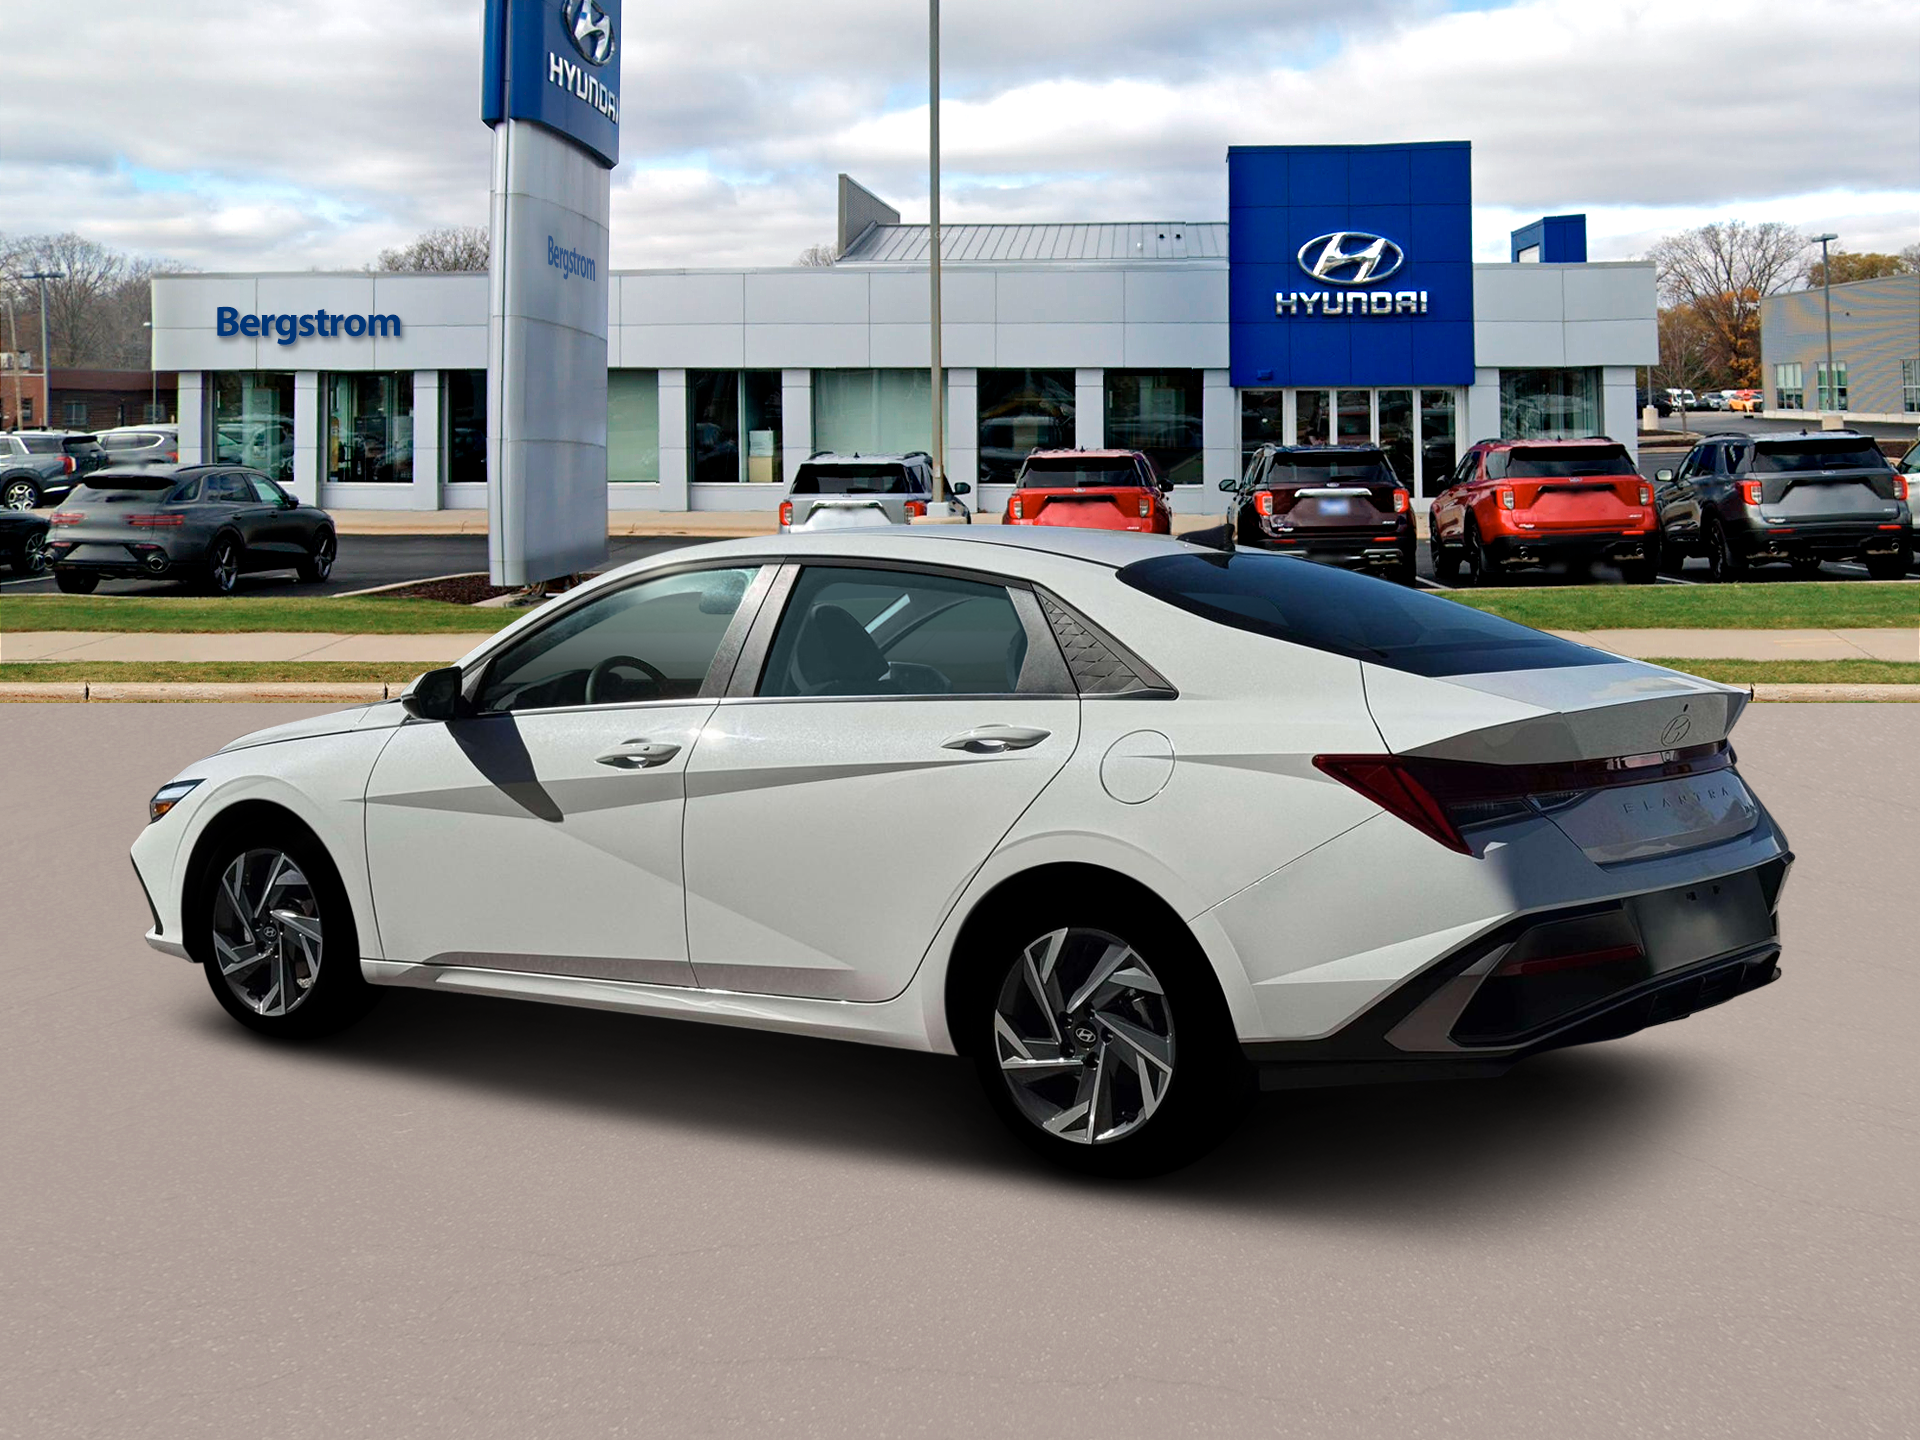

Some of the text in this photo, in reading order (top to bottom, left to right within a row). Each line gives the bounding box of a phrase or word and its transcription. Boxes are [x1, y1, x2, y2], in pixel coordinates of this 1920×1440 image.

[548, 51, 619, 124] HYUNDAI
[547, 234, 596, 282] Bergstrom
[1275, 290, 1428, 316] HYUNDAI
[216, 306, 402, 346] Bergstrom
[1622, 785, 1730, 815] ELANTRA
